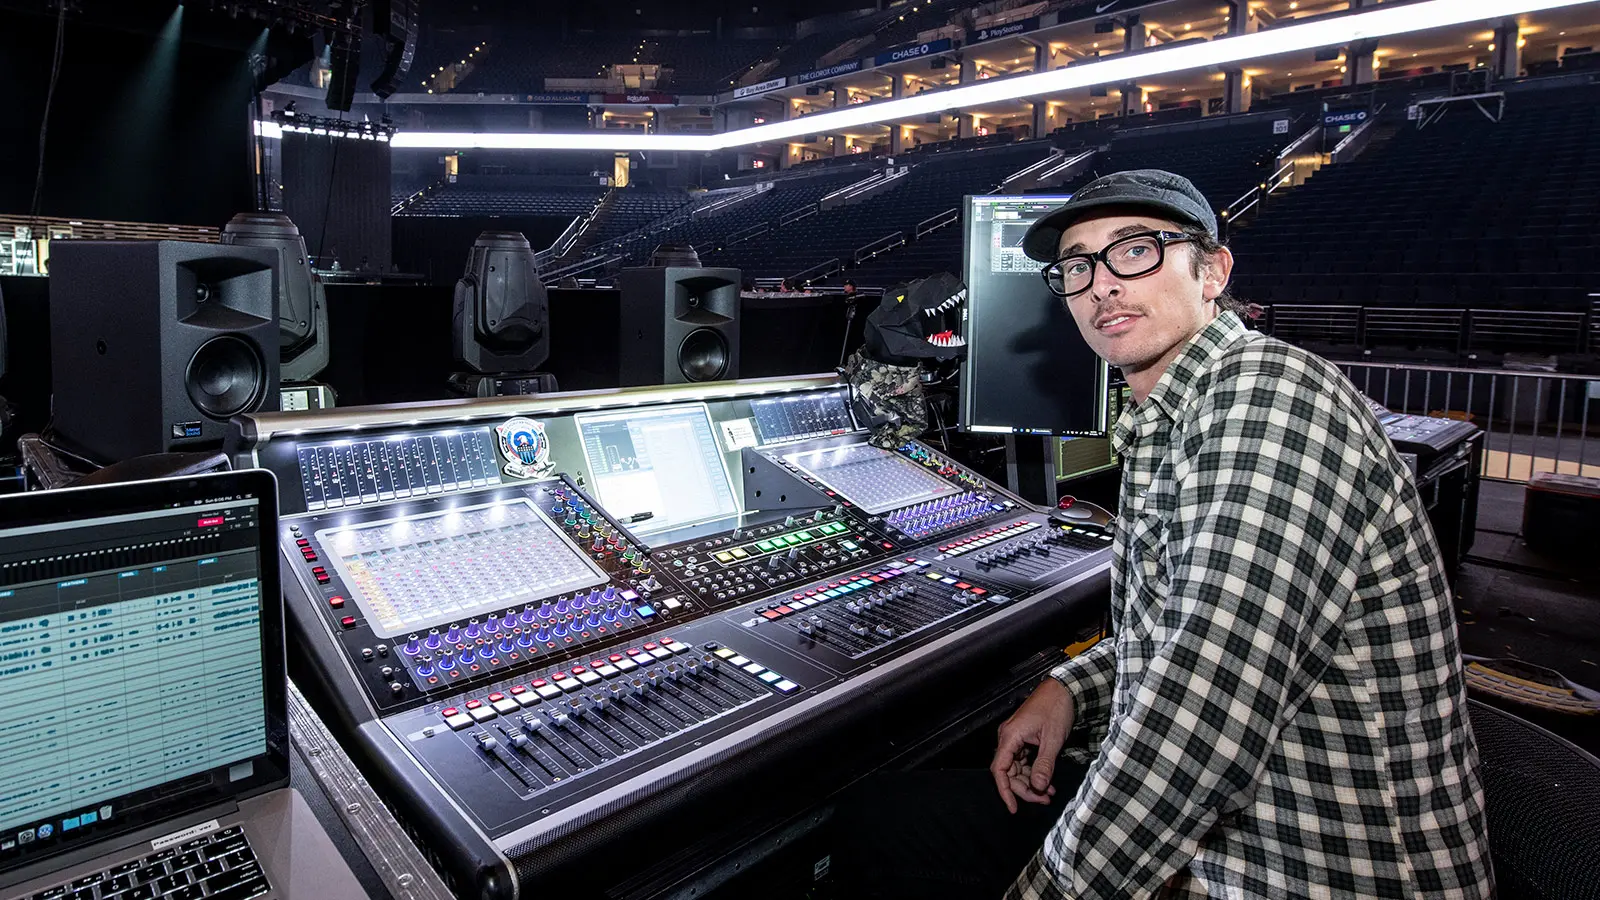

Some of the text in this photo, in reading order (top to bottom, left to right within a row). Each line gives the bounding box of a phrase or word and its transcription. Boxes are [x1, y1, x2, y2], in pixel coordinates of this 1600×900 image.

[990, 24, 1023, 37] PlayStation
[892, 47, 919, 60] CHASE
[800, 62, 858, 81] THE CLOROX COMPANY
[755, 84, 766, 92] Area
[766, 81, 780, 89] BMW
[627, 95, 650, 103] Rakuten
[1325, 113, 1357, 123] CHASE
[1275, 125, 1287, 133] 101
